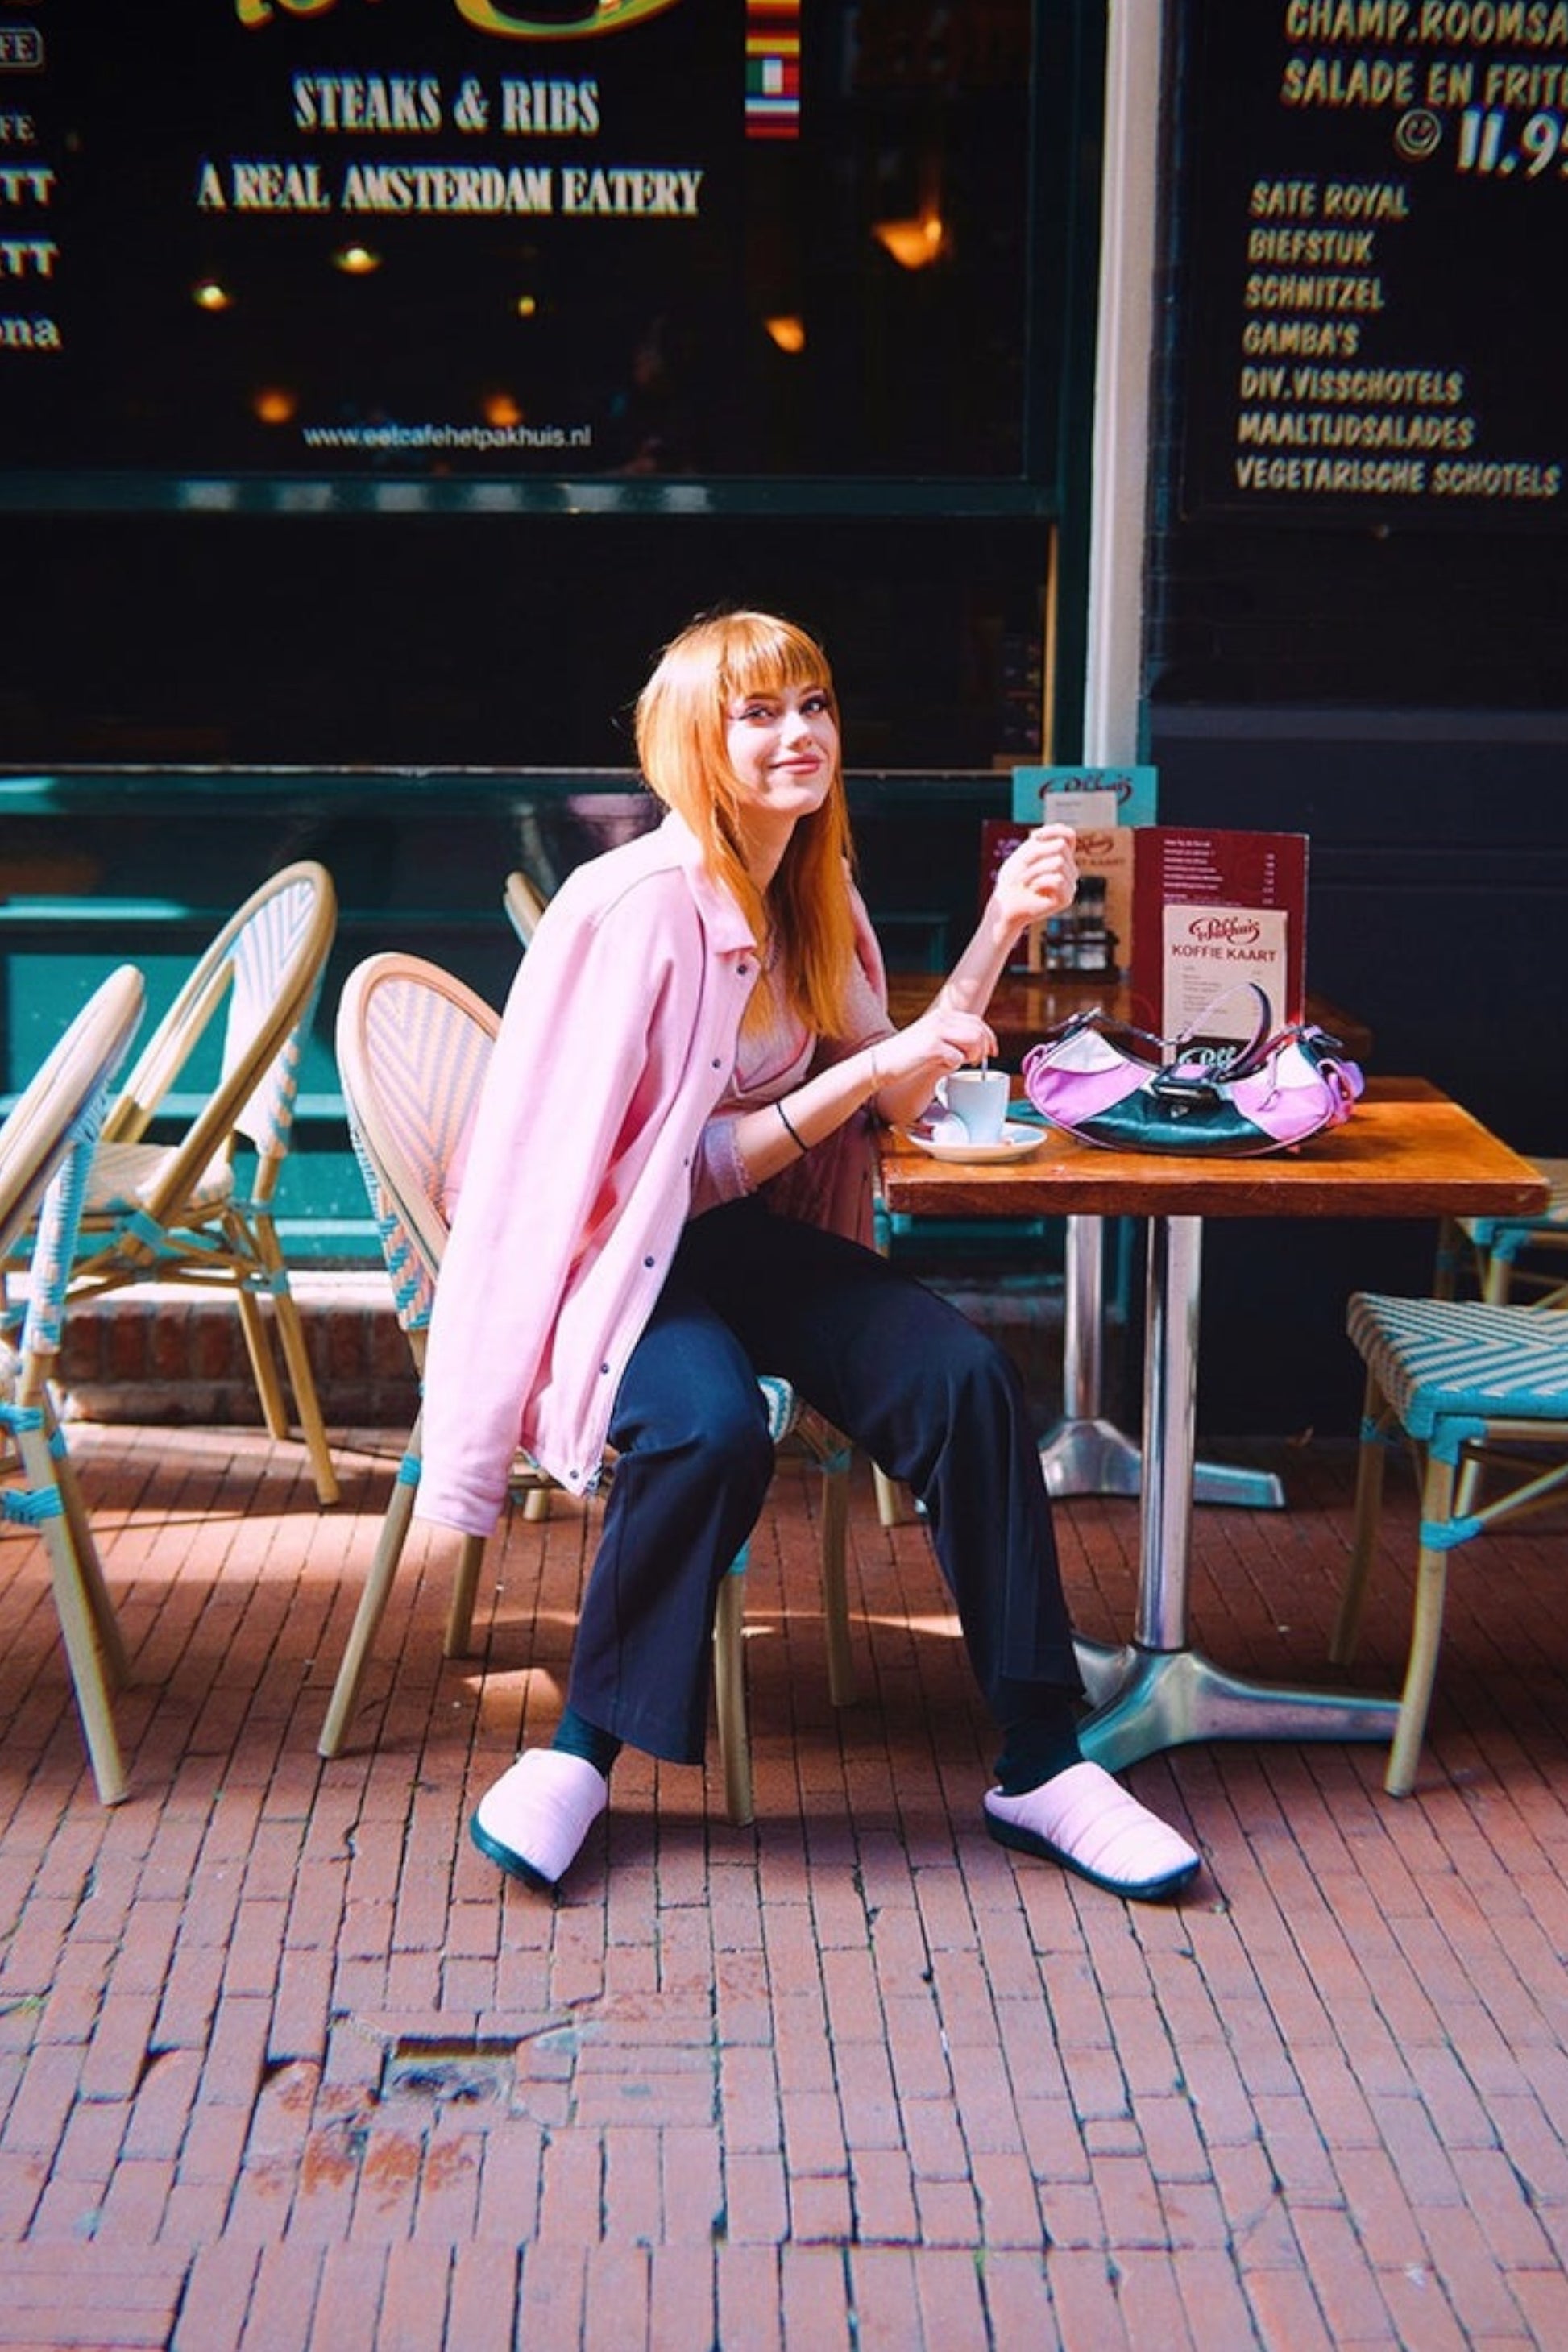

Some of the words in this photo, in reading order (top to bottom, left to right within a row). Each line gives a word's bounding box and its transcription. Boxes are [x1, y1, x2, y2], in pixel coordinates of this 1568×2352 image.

[1283, 58, 1416, 103] SALADE
[1427, 62, 1475, 106] EN
[293, 74, 442, 132] STEAKS
[454, 79, 490, 132] &
[501, 77, 599, 134] RIBS
[197, 161, 226, 211] A
[231, 163, 330, 213] REAL
[341, 166, 554, 214] AMSTERDAM
[562, 169, 703, 216] EATERY
[1249, 180, 1317, 218] SATE
[1323, 184, 1409, 219] ROYAL
[1247, 227, 1375, 264] BIEFSTUK
[1244, 274, 1385, 310] SCHNITZEL
[1242, 321, 1360, 356] GAMBA'S
[1240, 367, 1463, 403] DIV.VISSCHOTELS
[303, 425, 592, 450] www.eetcafehetpakhuis.nl
[1238, 413, 1475, 449] MAALTIJDSALADES
[1235, 457, 1425, 492] VEGETARISCHE
[1433, 463, 1561, 497] SCHOTELS
[1172, 944, 1223, 959] KOFFIE
[1226, 948, 1276, 962] KAART
